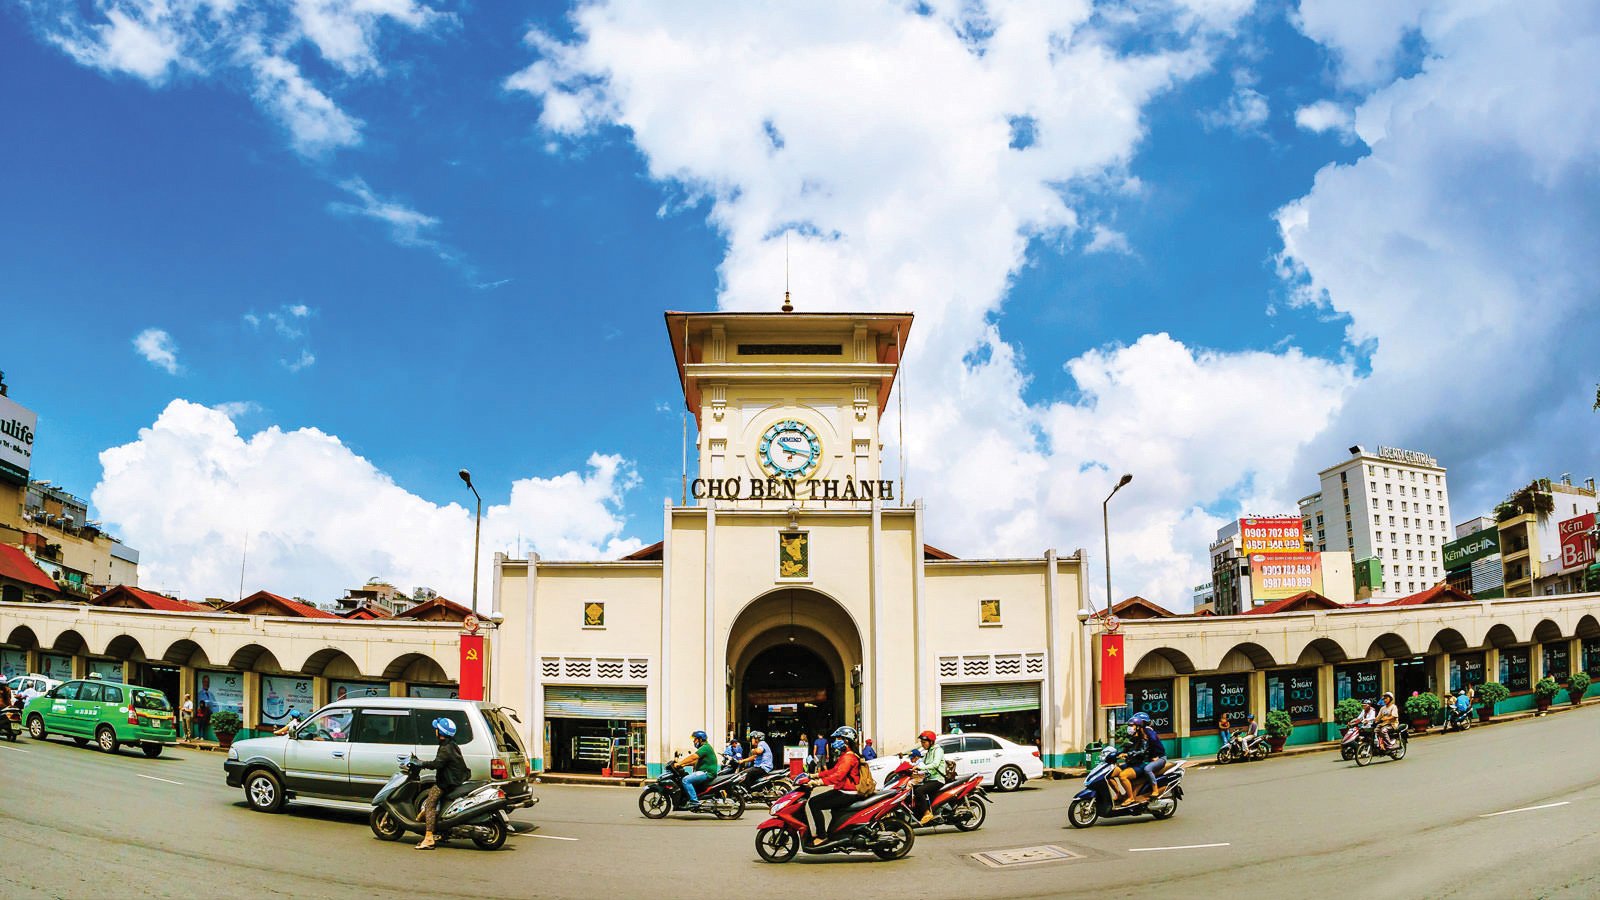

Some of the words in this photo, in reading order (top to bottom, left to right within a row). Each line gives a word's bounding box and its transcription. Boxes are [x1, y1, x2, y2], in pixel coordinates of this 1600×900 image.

[1379, 446, 1404, 460] LIBERTY
[1404, 449, 1432, 464] CENTRAL
[691, 476, 742, 502] CHỢ
[805, 475, 894, 500] THÀNH
[1244, 528, 1267, 538] 0903
[1267, 528, 1283, 538] 702
[1284, 527, 1299, 538] 689
[1356, 671, 1362, 682] 3
[295, 682, 307, 690] PS
[1220, 683, 1227, 695] 3
[1290, 678, 1297, 689] 3
[1141, 689, 1148, 701] 3
